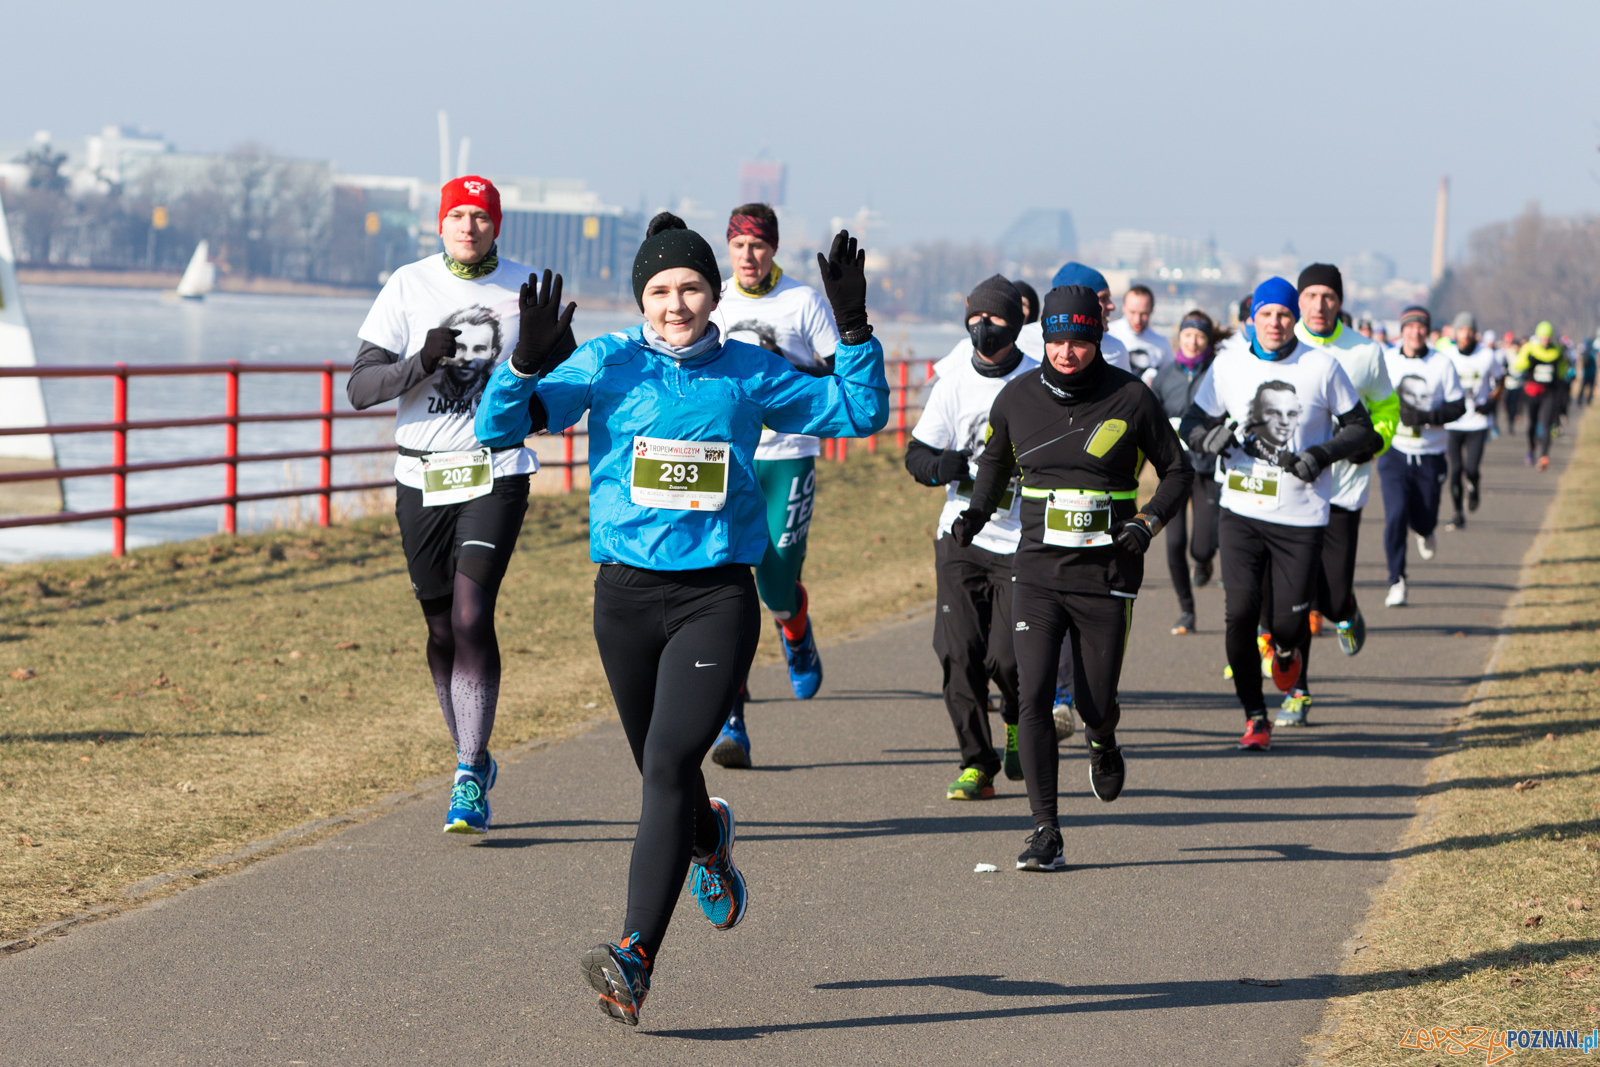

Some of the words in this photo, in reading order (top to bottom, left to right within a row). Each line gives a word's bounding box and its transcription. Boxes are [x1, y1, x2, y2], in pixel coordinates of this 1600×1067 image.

[1045, 313, 1069, 327] ICE
[442, 467, 472, 485] 202
[658, 463, 699, 483] 293
[1240, 477, 1264, 492] 463
[1064, 511, 1093, 528] 169
